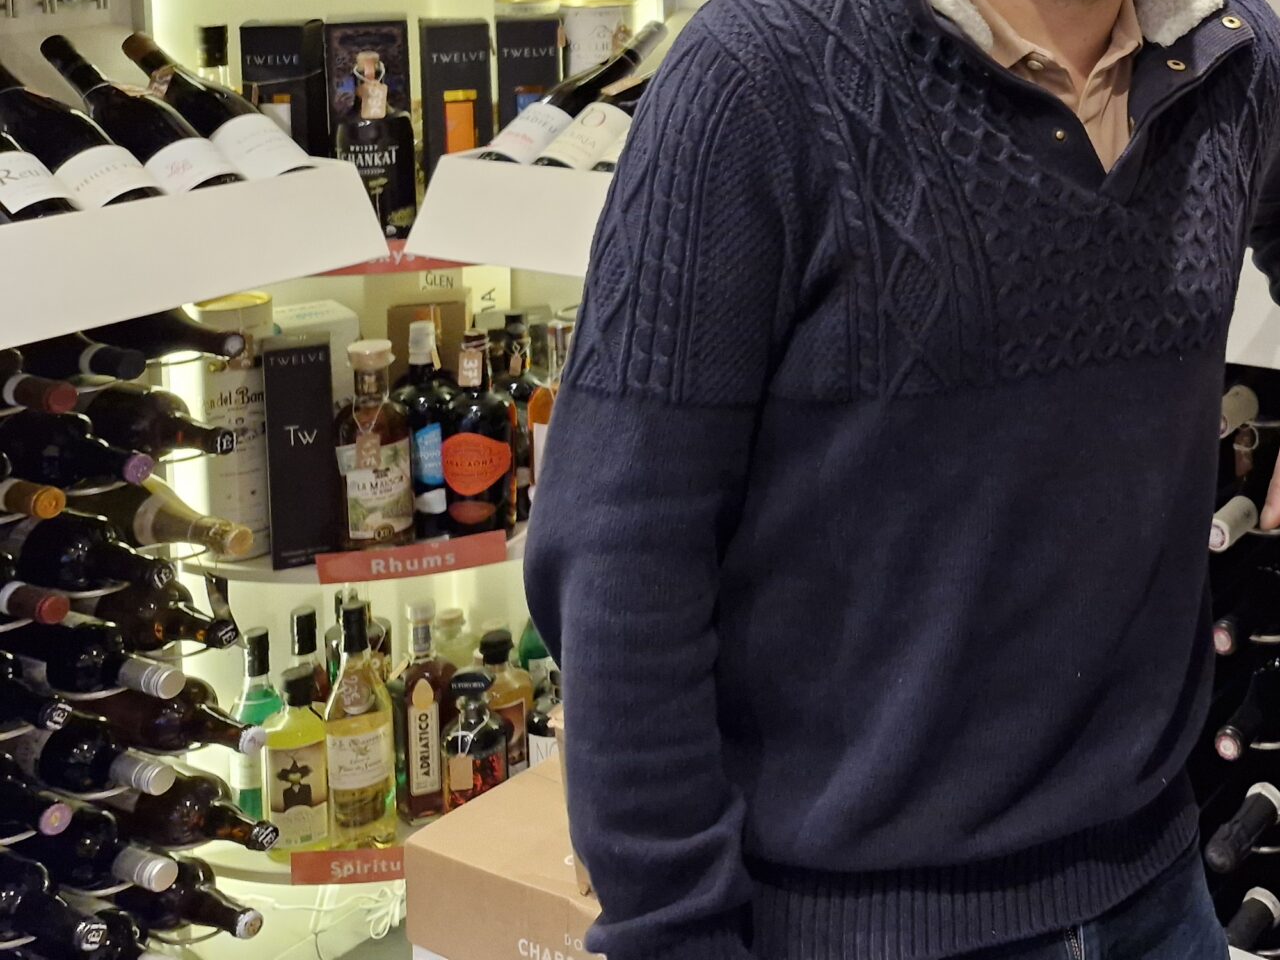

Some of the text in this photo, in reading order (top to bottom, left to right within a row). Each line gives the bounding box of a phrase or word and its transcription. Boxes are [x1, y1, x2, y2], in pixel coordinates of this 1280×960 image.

[245, 54, 300, 66] TWELVE
[431, 51, 486, 64] TWELVE
[502, 46, 556, 59] TWELVE
[425, 270, 455, 289] GLEN
[269, 350, 327, 367] TWELVE
[371, 553, 456, 576] Rhums
[418, 712, 432, 778] ADRIATICO
[329, 857, 402, 880] Spiritu
